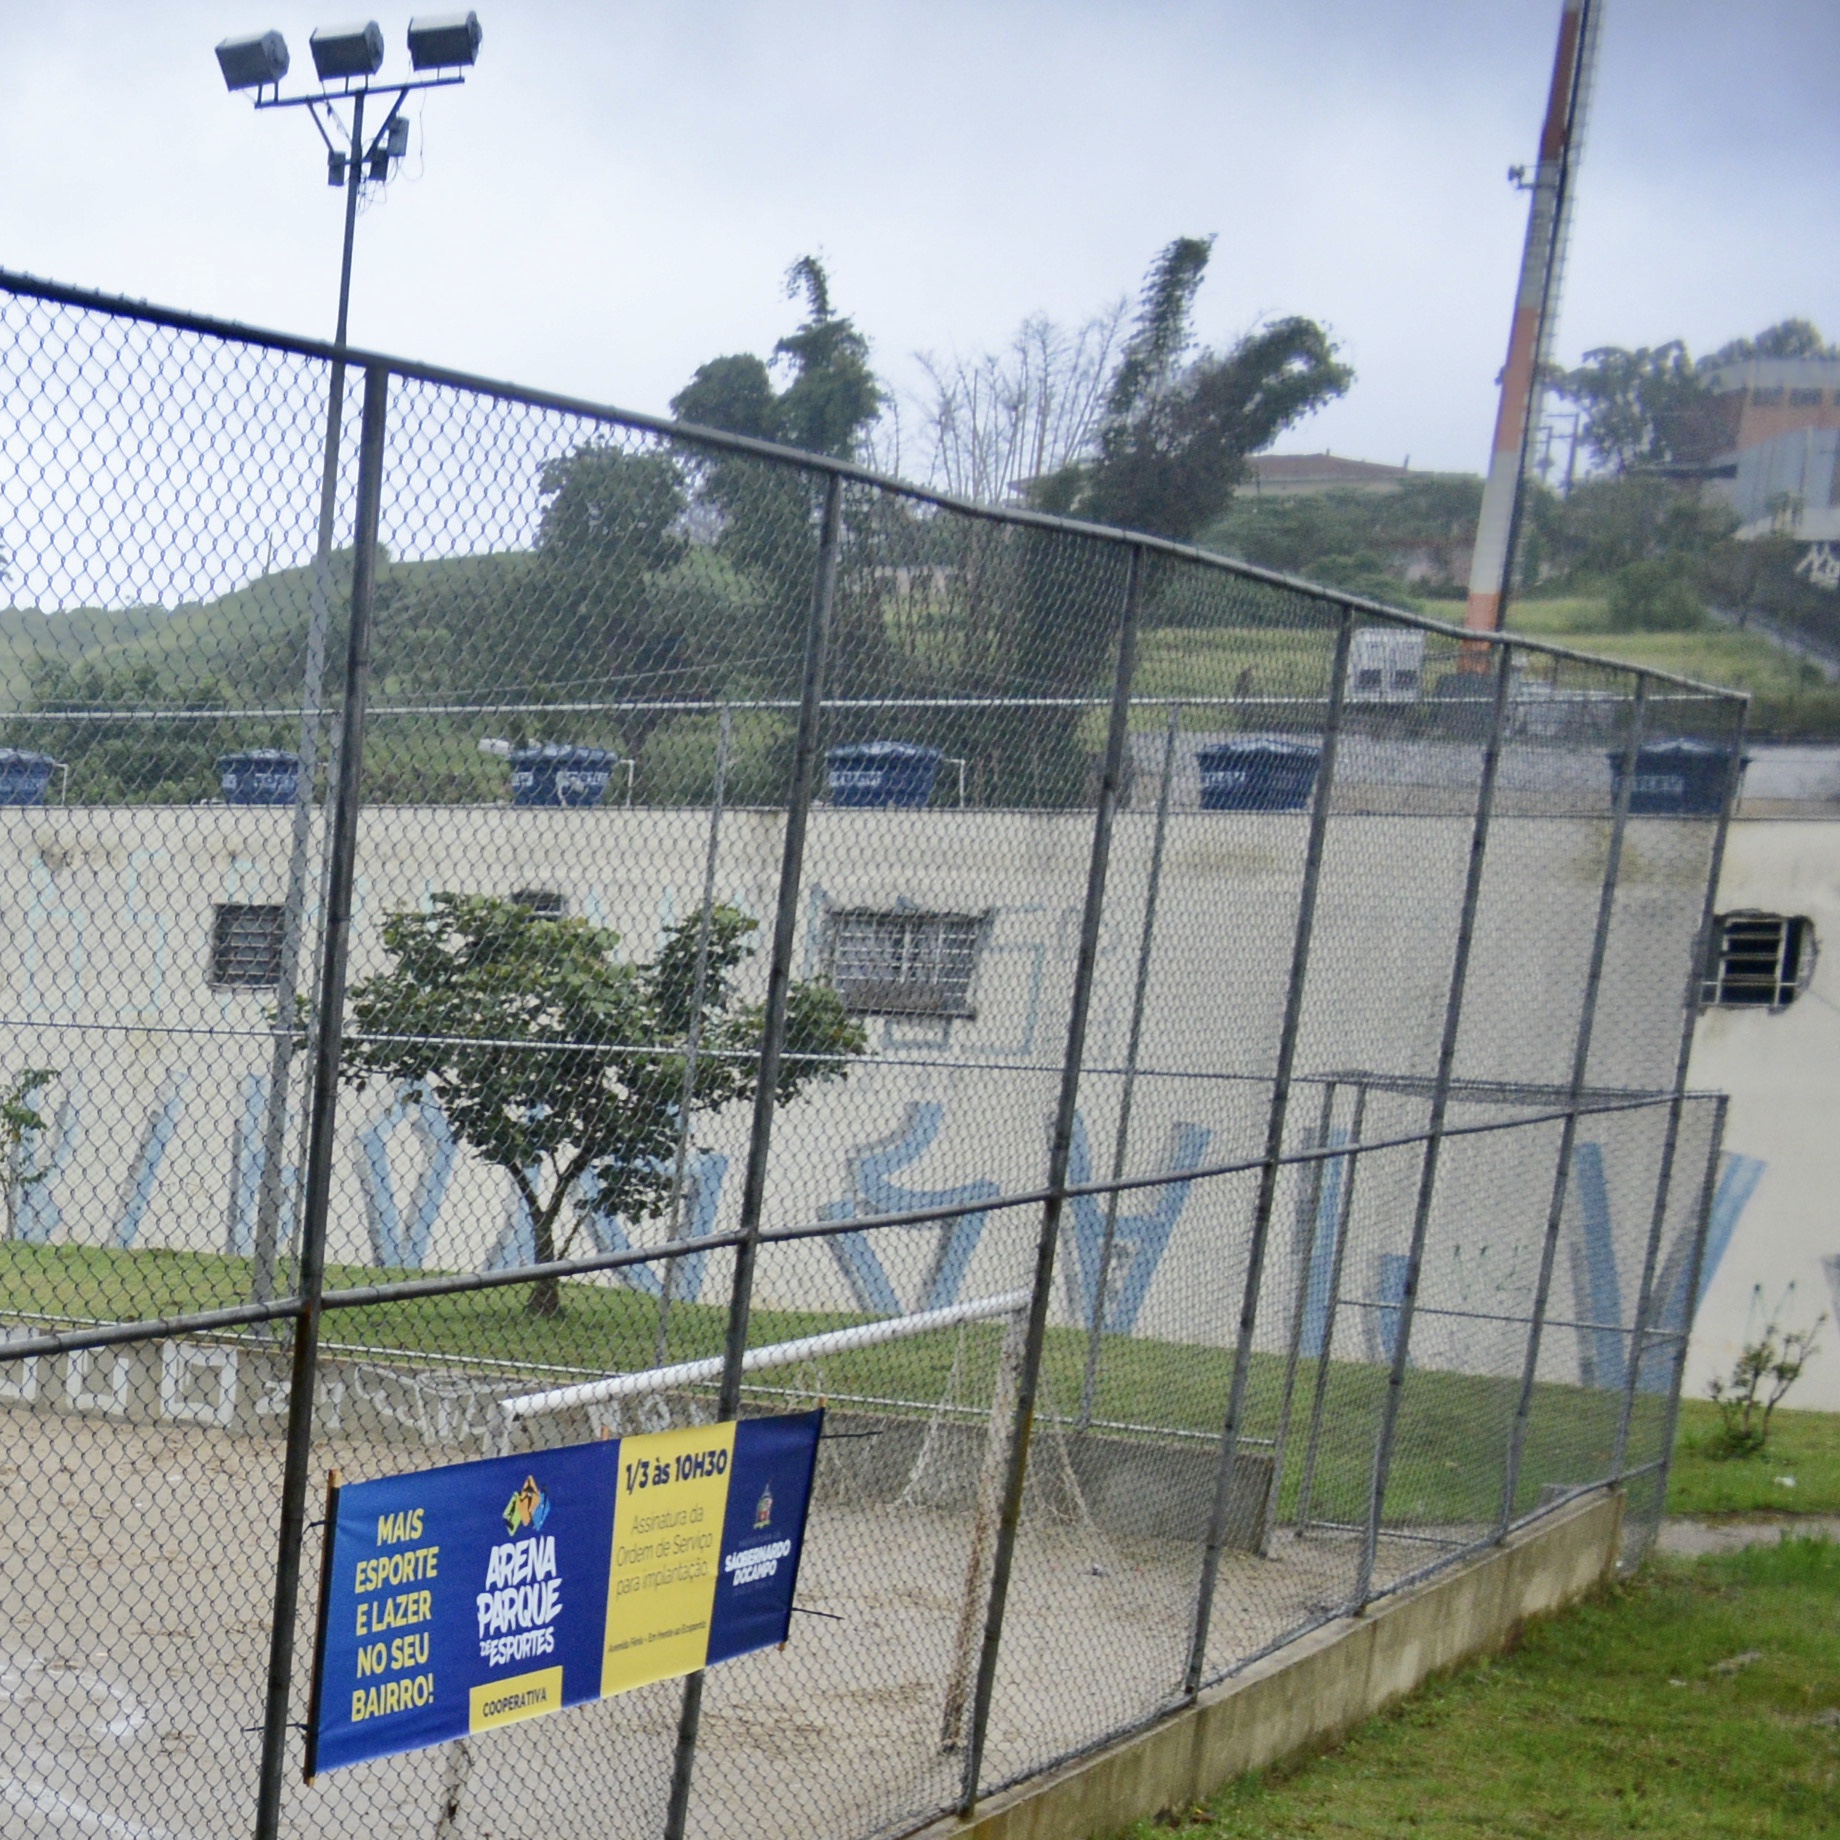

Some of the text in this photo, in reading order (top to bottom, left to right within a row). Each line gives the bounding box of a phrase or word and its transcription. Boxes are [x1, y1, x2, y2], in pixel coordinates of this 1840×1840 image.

[626, 1448, 728, 1495] 1/3 às 10H30
[376, 1508, 425, 1547] MAIS
[631, 1504, 704, 1534] Assinatura da
[354, 1546, 439, 1594] ESPORTE
[485, 1535, 557, 1592] ARENA
[617, 1544, 654, 1567] Ordem
[656, 1537, 671, 1558] de
[673, 1531, 713, 1564] Serviço
[476, 1577, 563, 1639] PARQUE
[615, 1576, 640, 1602] para
[356, 1589, 432, 1637] E LAZER
[356, 1631, 430, 1679] NO SEU
[489, 1626, 555, 1668] ESPORTES
[350, 1672, 434, 1723] BAIRRO!
[482, 1687, 547, 1718] COOPERATIVA
